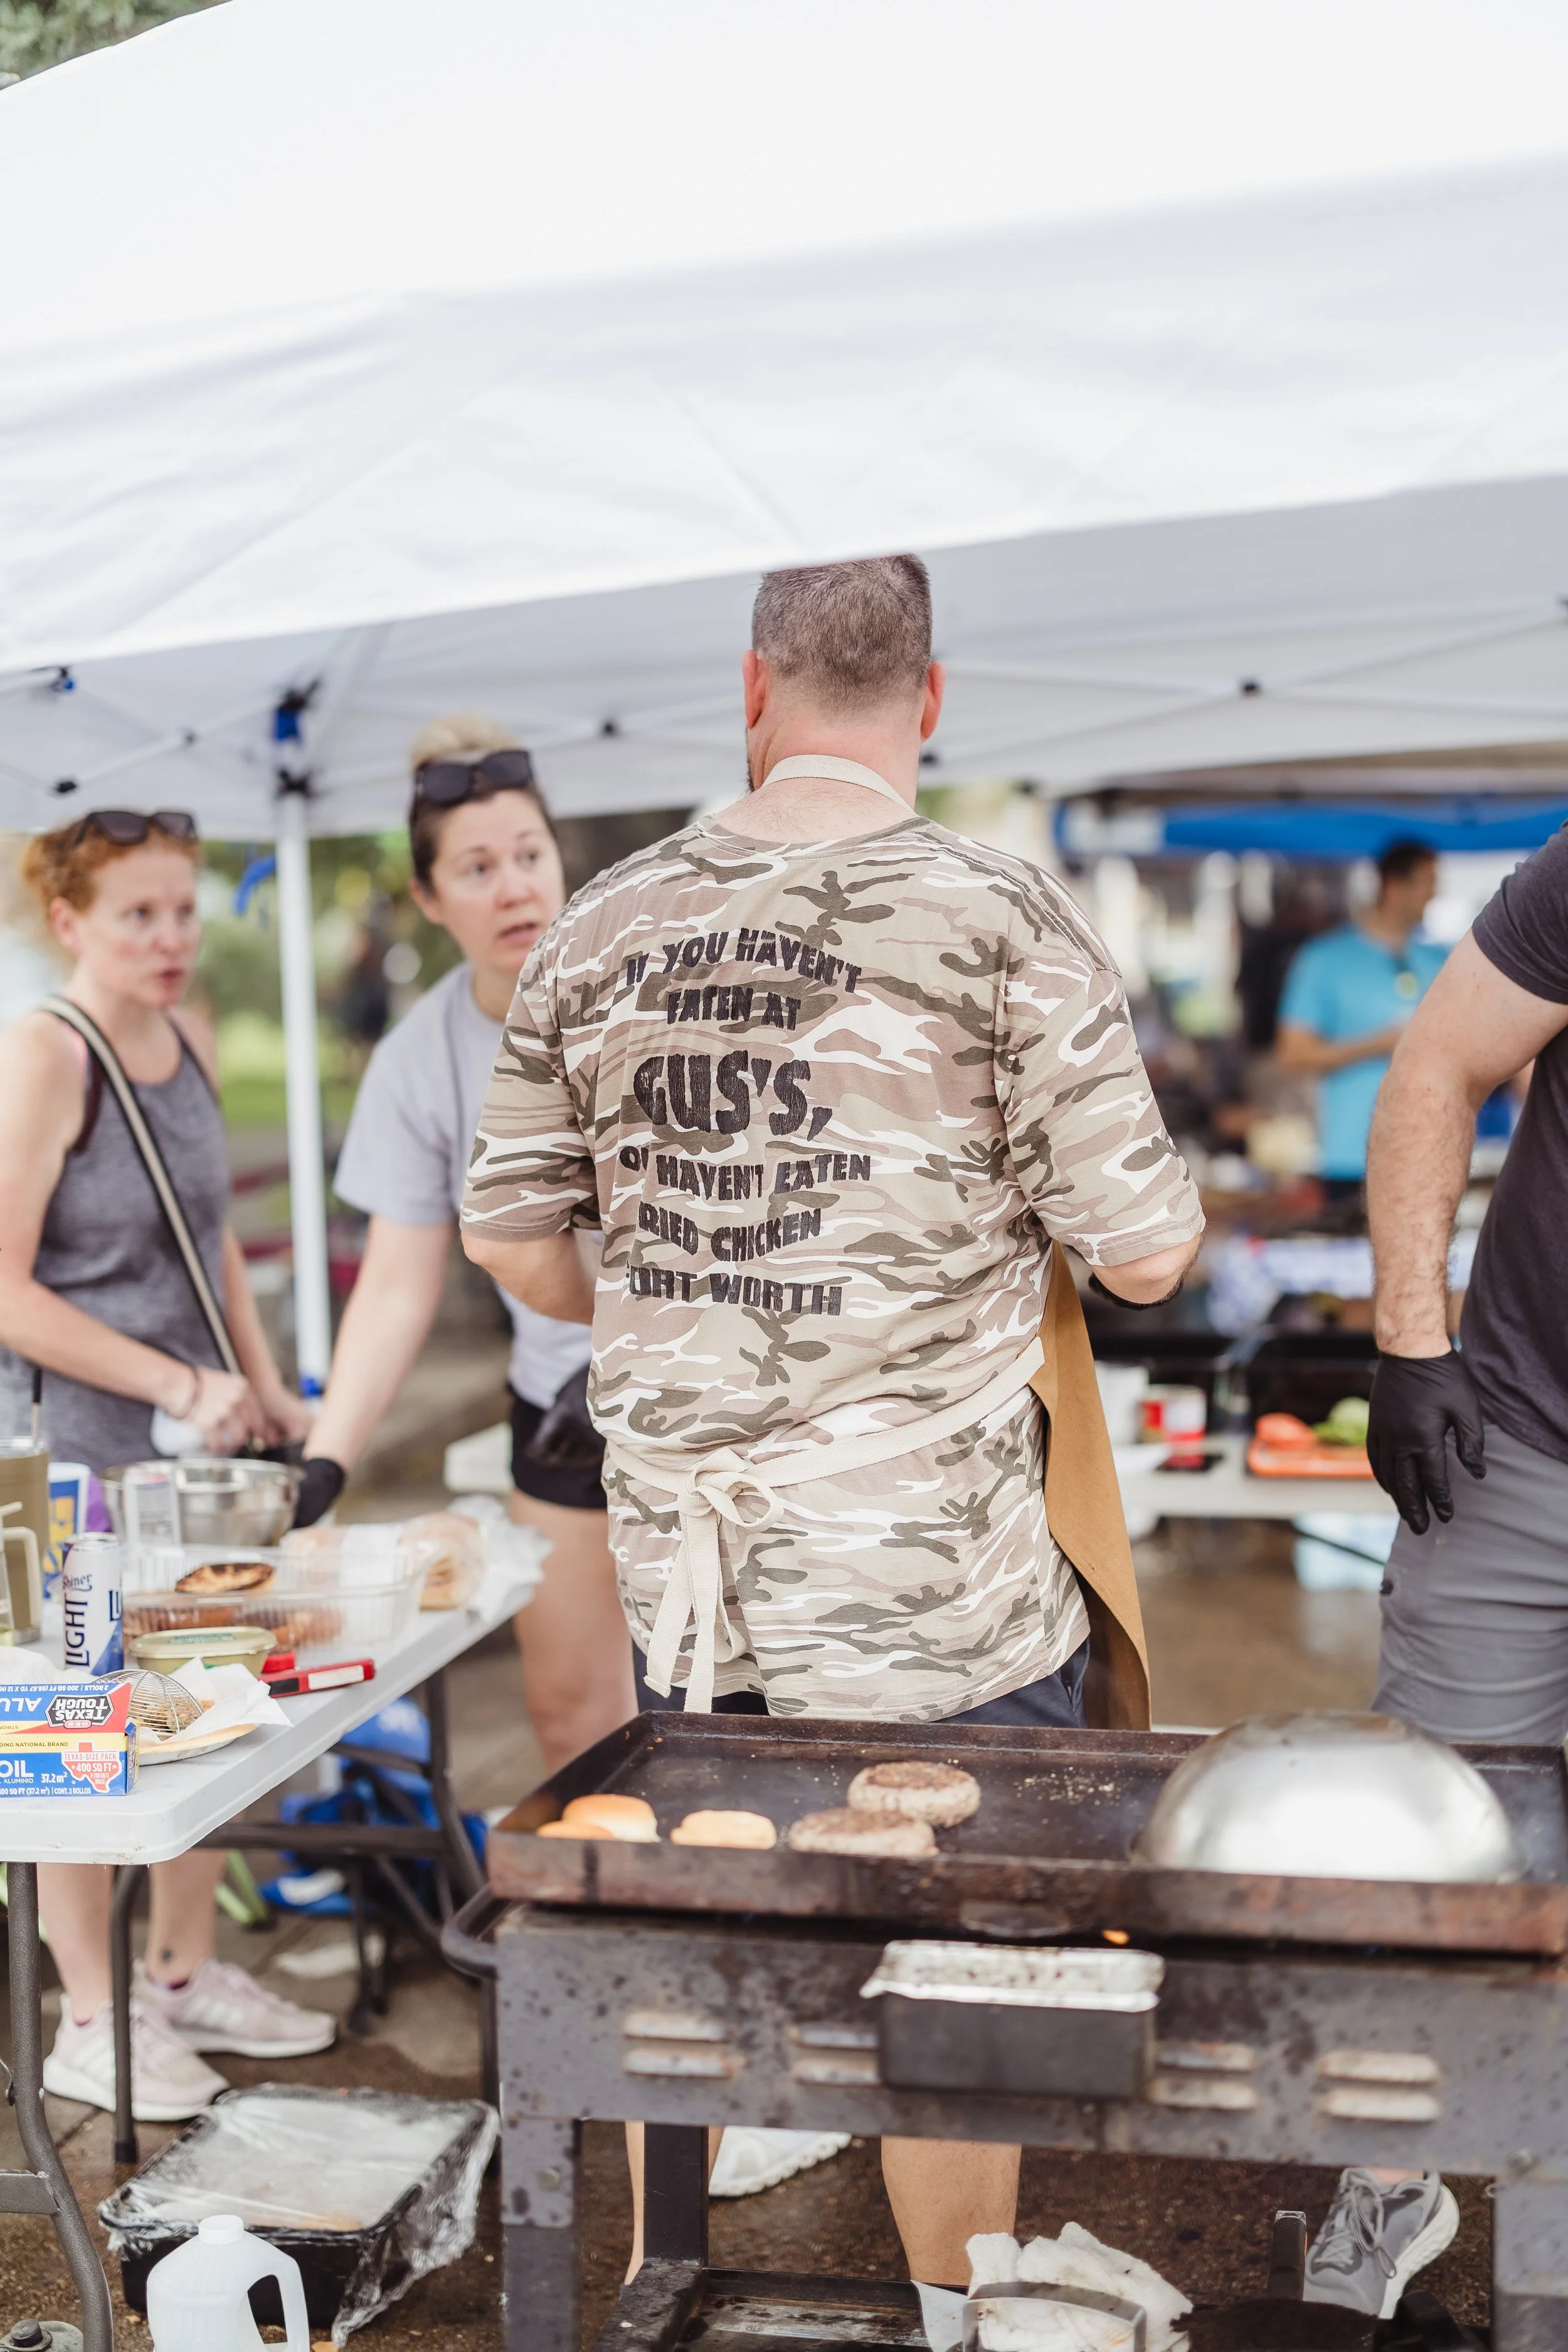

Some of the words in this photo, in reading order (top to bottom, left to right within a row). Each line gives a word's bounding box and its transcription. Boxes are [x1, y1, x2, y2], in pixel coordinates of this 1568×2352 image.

[662, 931, 729, 974] YOU
[735, 928, 862, 993] HAVEN'T
[761, 992, 801, 1030] AT
[633, 1049, 832, 1141] GUS'S,
[656, 1154, 764, 1200] HAVEN'T
[775, 1154, 871, 1194] EATEN
[638, 1200, 699, 1256] RIED
[711, 1208, 821, 1261] CHICKEN
[626, 1261, 697, 1303] ORT
[709, 1273, 842, 1316] WORTH
[55, 1698, 109, 1710] TOUGH
[55, 1709, 105, 1721] TEXAS
[76, 1763, 91, 1772] 400
[92, 1763, 103, 1772] SQ
[103, 1762, 112, 1772] FT
